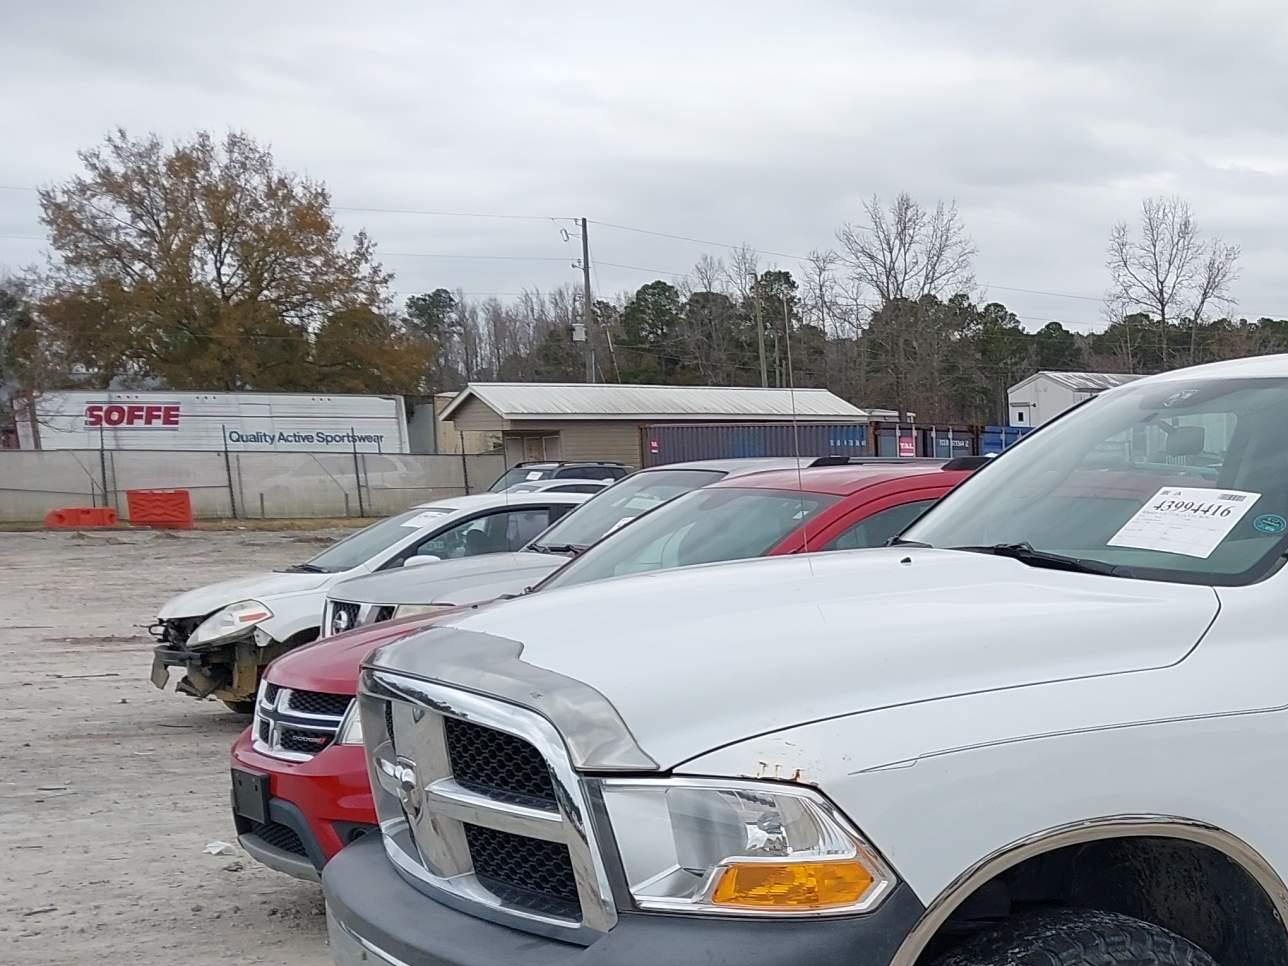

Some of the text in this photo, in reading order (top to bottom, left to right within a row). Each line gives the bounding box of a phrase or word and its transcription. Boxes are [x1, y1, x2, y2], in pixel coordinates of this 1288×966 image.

[85, 405, 180, 426] SOFFE
[229, 430, 384, 445] Quality Active Sportswear
[1153, 499, 1235, 517] 43994416
